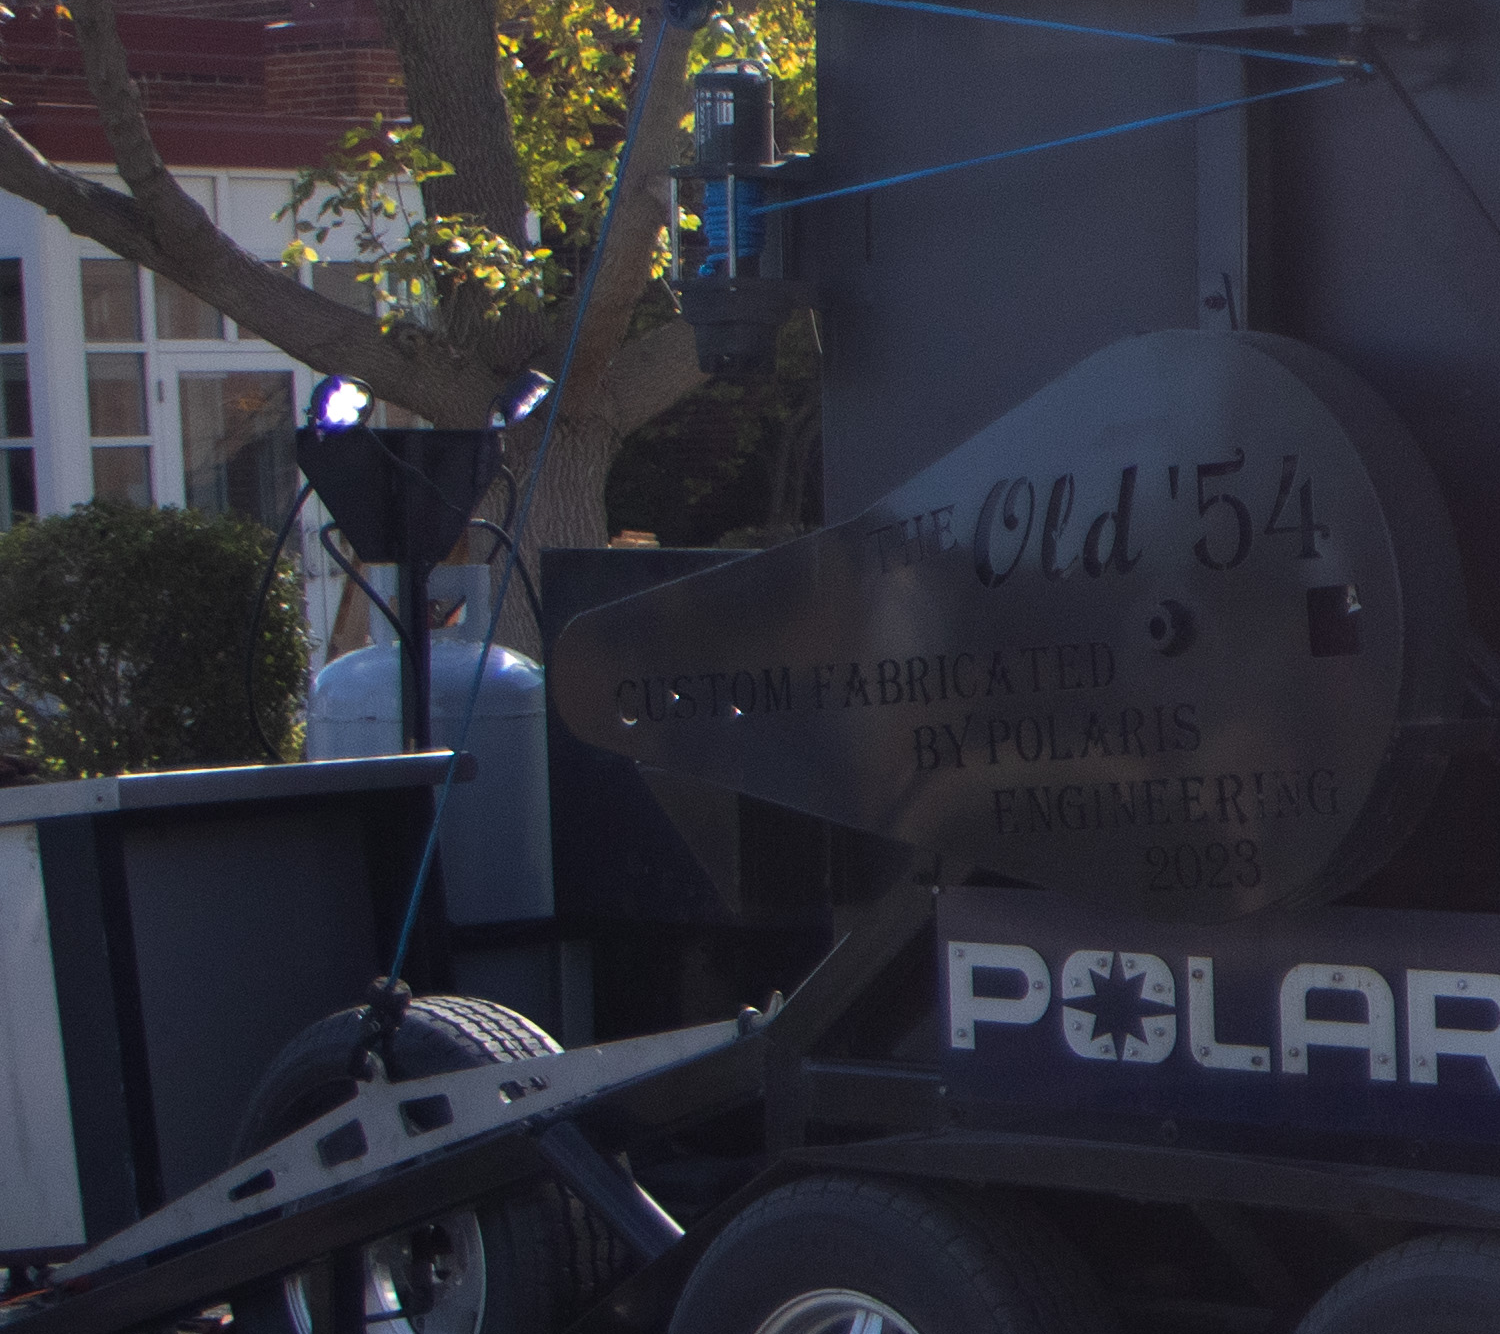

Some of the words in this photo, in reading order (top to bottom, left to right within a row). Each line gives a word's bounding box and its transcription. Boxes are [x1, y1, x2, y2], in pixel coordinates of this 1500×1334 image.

[866, 504, 960, 578] THE
[972, 464, 1151, 591] Old
[1165, 448, 1332, 573] '54
[615, 665, 795, 728] CUSTOM
[813, 640, 1117, 712] FABRICATED
[912, 715, 975, 774] BY
[986, 702, 1203, 765] POLARIS
[992, 767, 1343, 837] ENGINEERING
[1145, 838, 1263, 892] 2023
